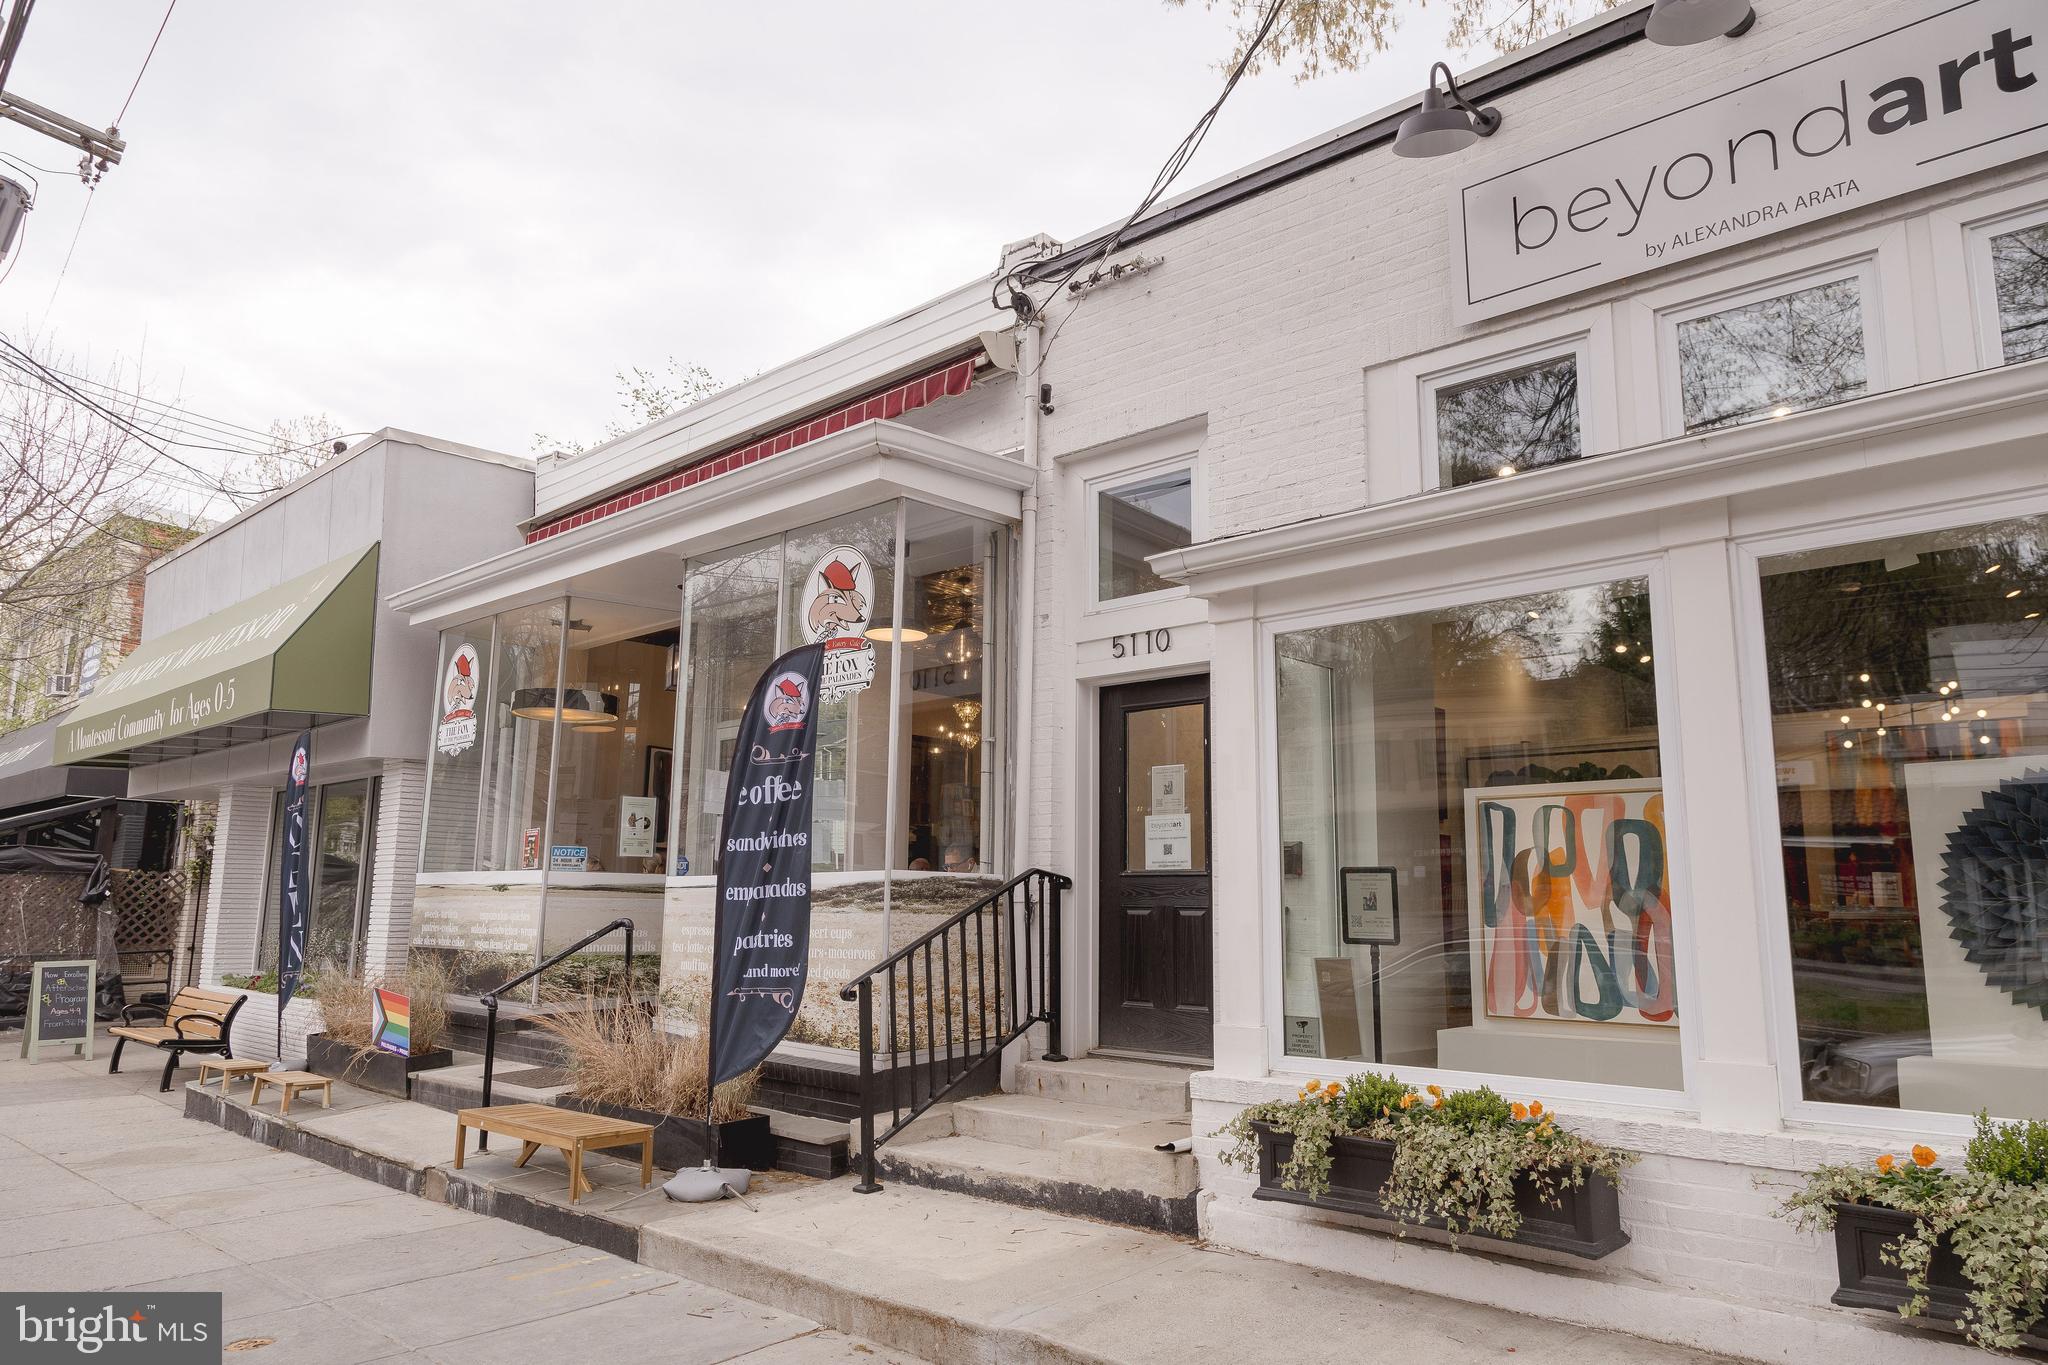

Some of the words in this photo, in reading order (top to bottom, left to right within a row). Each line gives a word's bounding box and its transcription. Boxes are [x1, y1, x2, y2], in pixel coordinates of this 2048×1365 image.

[1512, 27, 2038, 255] beyondart
[1645, 242, 1666, 258] by
[1671, 201, 1788, 250] ALEXANDRA
[1794, 179, 1860, 212] ARATA
[1113, 628, 1170, 658] 5110
[835, 658, 858, 674] FOX
[828, 672, 862, 684] PALISADES
[68, 730, 74, 753] A
[77, 722, 117, 750] Montessori
[118, 709, 166, 741] Community
[170, 698, 184, 727] for
[185, 692, 212, 727] Ages
[215, 678, 236, 713] 0-5
[739, 775, 802, 806] coffee
[553, 848, 586, 857] NOTICE
[733, 928, 794, 956] pastries
[830, 928, 853, 943] cups
[828, 947, 876, 960] macarons
[44, 971, 59, 979] Now
[56, 994, 88, 1006] Program
[50, 1007, 69, 1016] Ages
